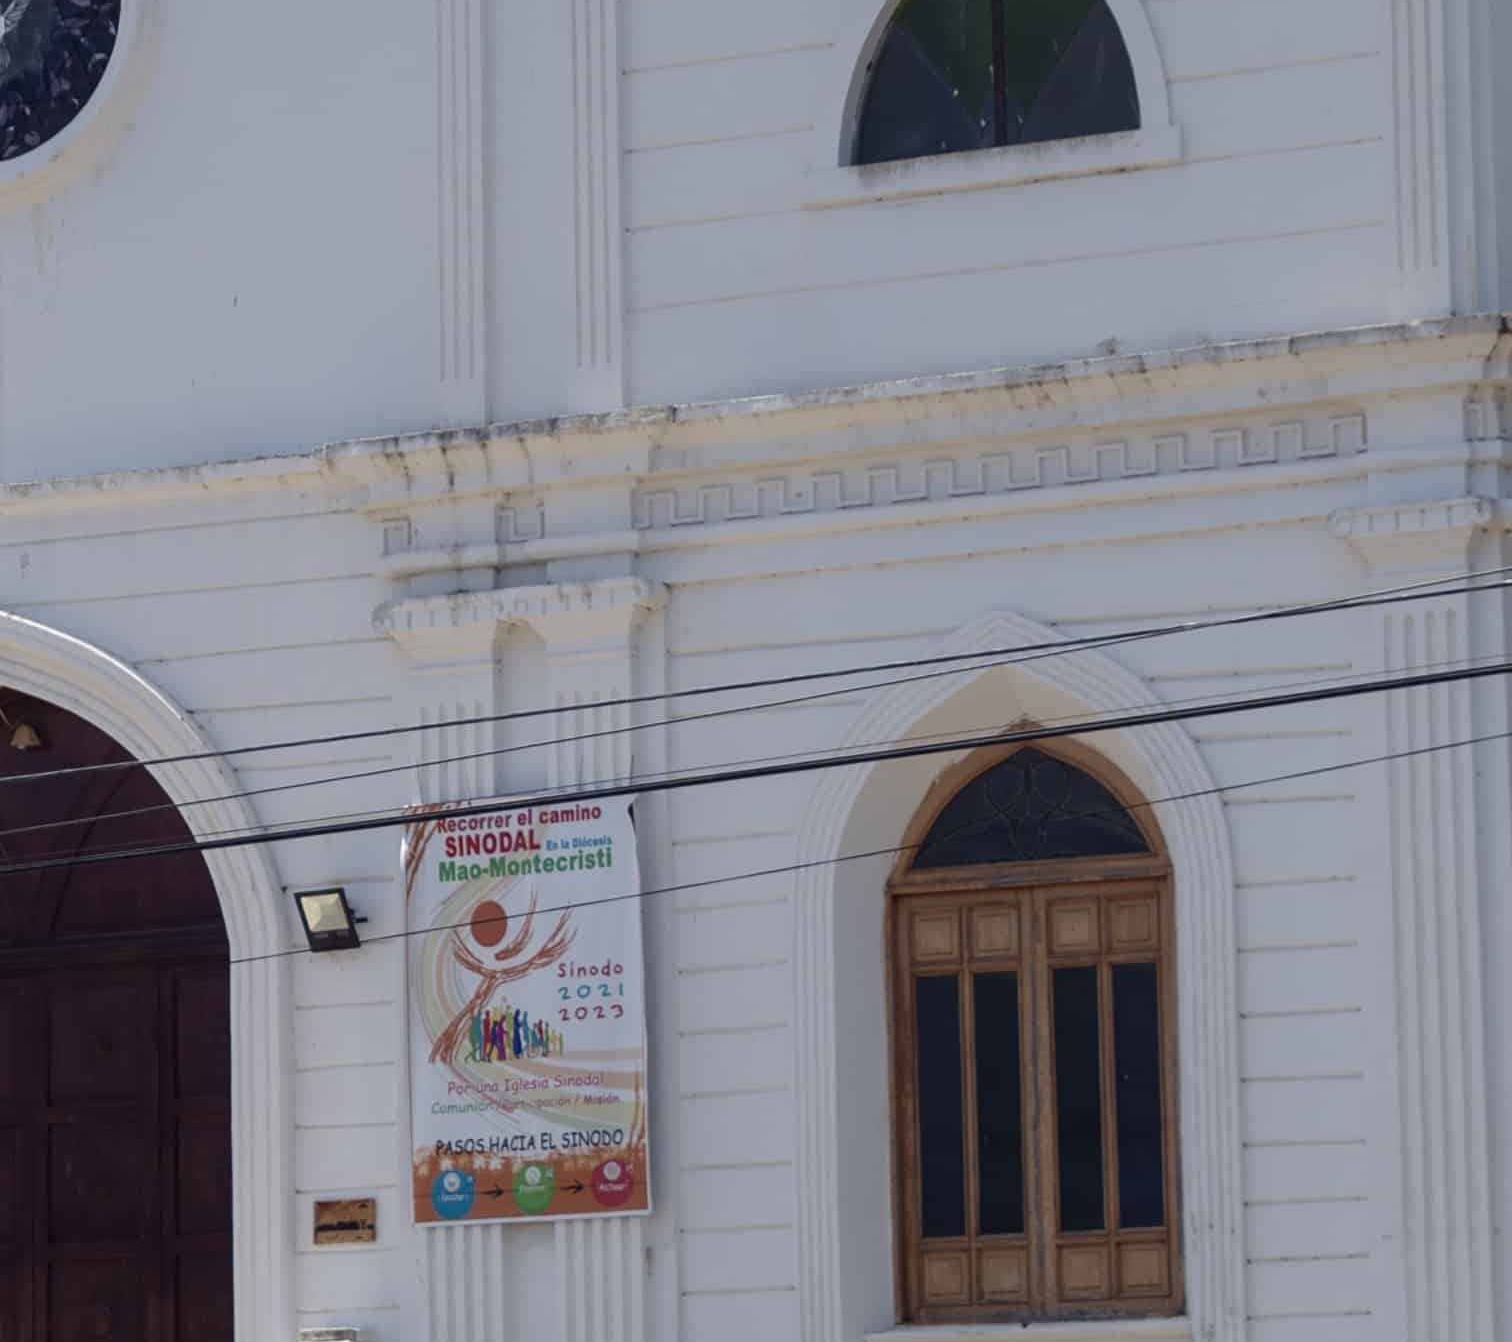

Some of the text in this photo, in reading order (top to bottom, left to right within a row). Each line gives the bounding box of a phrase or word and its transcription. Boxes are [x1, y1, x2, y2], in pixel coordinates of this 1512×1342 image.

[436, 804, 602, 833] Recorrer el camino
[445, 828, 541, 858] SINODAL
[439, 846, 612, 883] Mao-Montecristi
[558, 982, 624, 1000] 2021
[558, 1004, 624, 1021] 2023
[504, 1076, 549, 1095] Iglesia
[435, 1139, 485, 1155] PASOS
[489, 1135, 535, 1152] HACIA
[540, 1132, 556, 1150] EL
